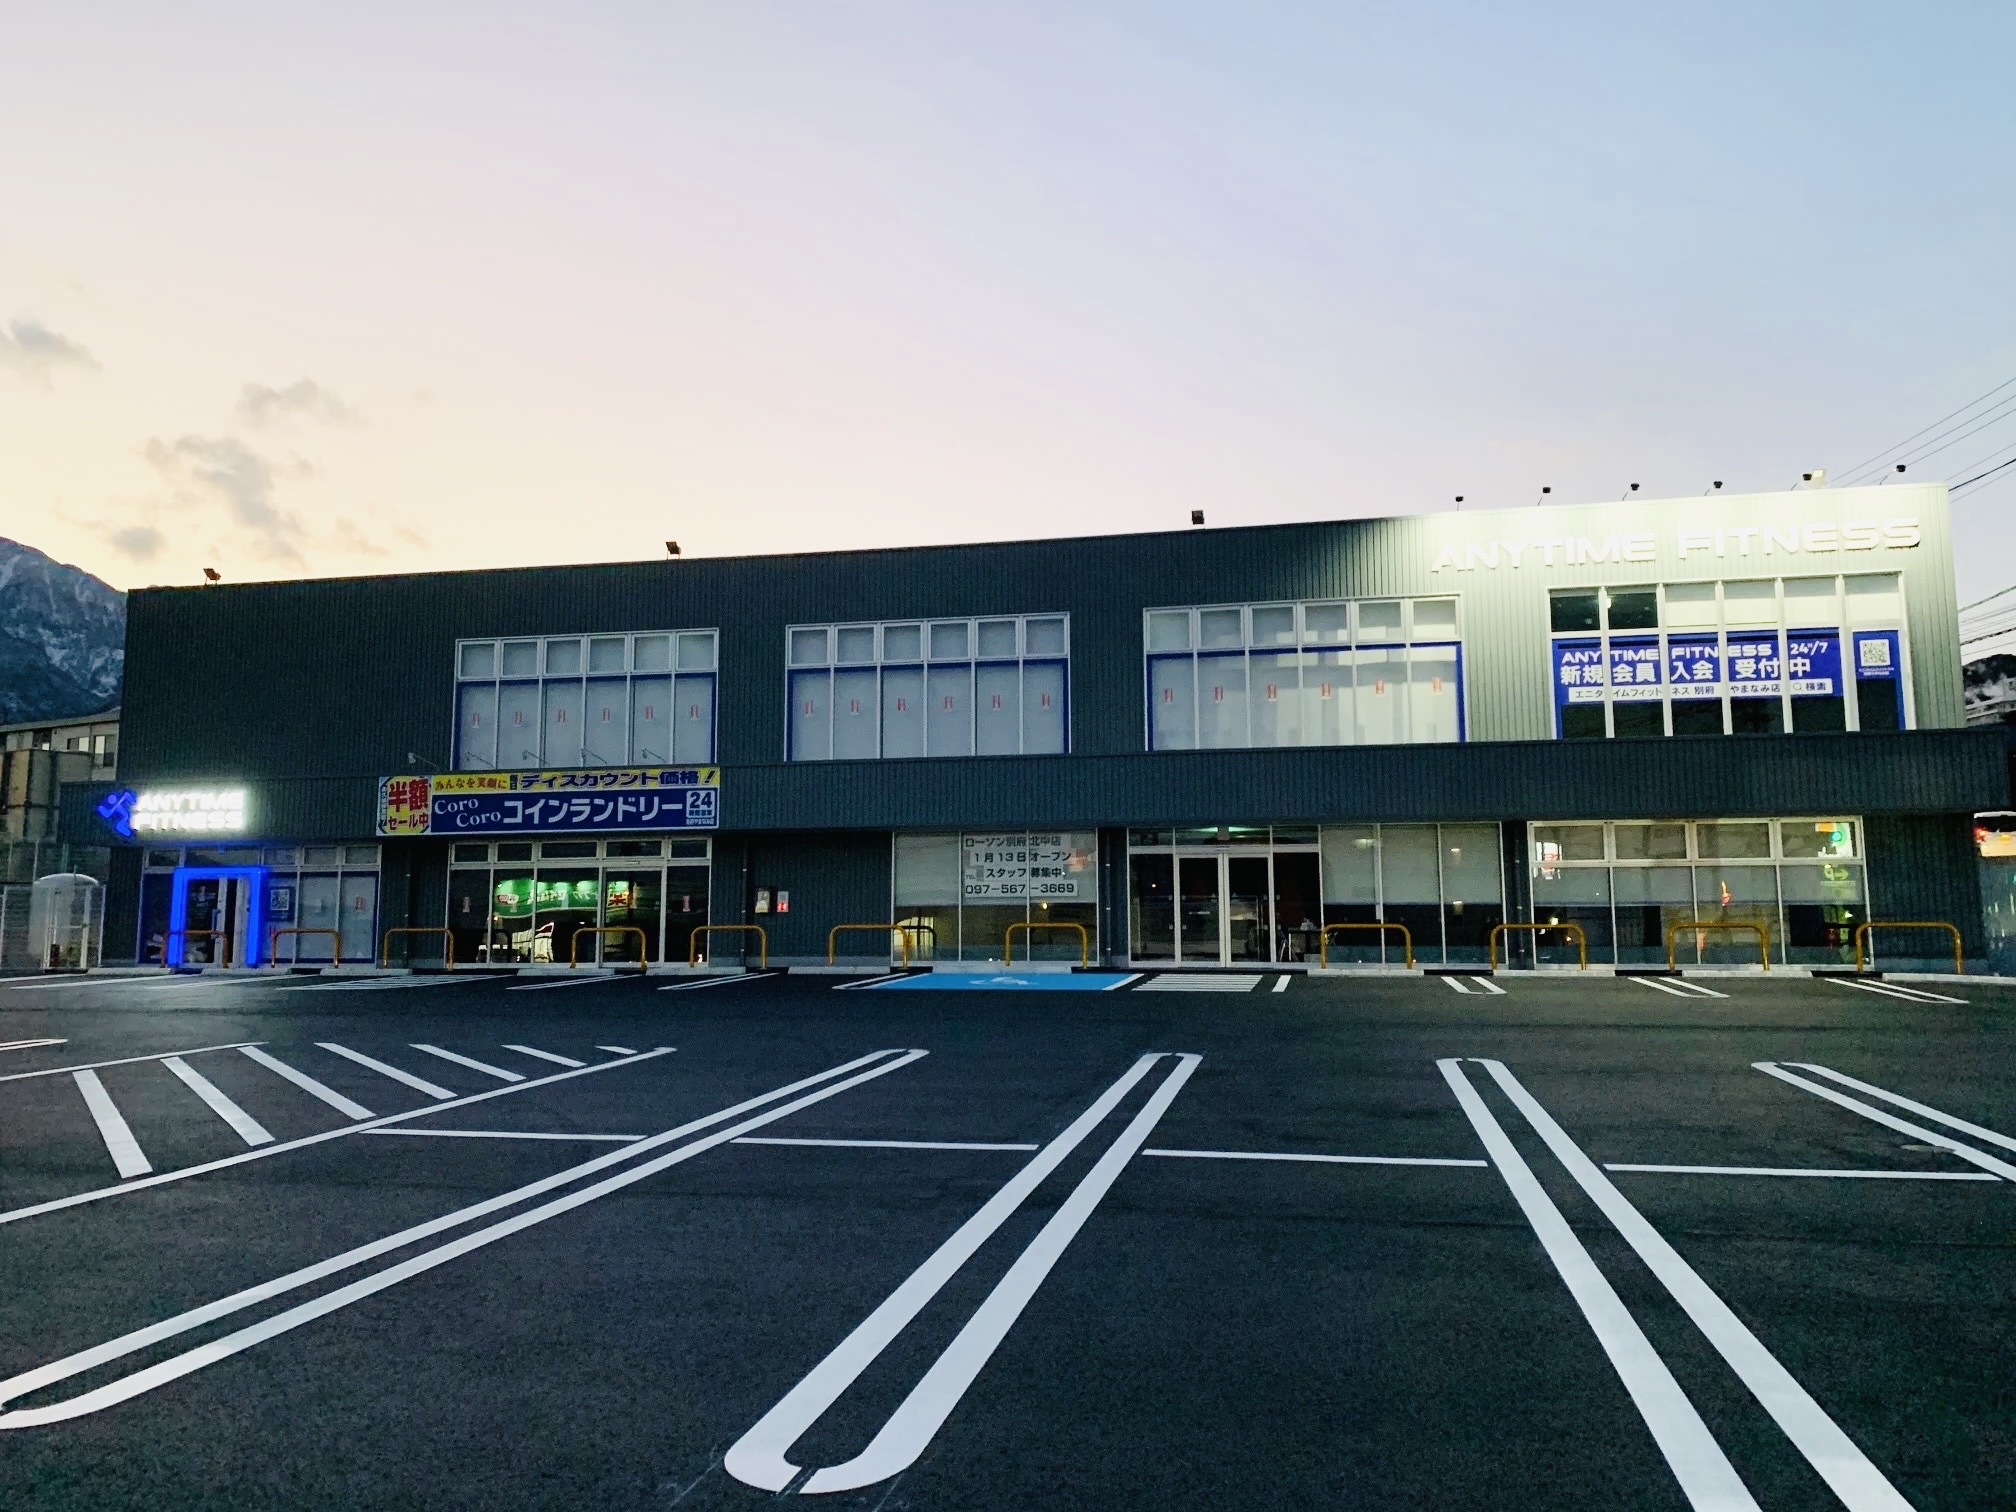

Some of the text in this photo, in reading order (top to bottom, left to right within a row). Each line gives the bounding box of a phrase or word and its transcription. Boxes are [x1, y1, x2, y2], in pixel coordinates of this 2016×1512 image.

[1431, 517, 1922, 572] ANYTIME FITNESS
[1561, 648, 1660, 664] ANYTIME
[1671, 643, 1773, 660] FITNESS
[1560, 656, 1811, 686] 新規会員入会受付中
[135, 791, 244, 811] ANYTIME
[388, 778, 429, 813] 半額
[689, 791, 713, 809] 24
[434, 798, 479, 815] Coro
[503, 796, 684, 825] コインランドリー
[132, 811, 244, 832] FITNESS
[388, 812, 429, 831] セール中
[456, 811, 502, 828] Coro
[986, 867, 1062, 879] スタッフ募集中
